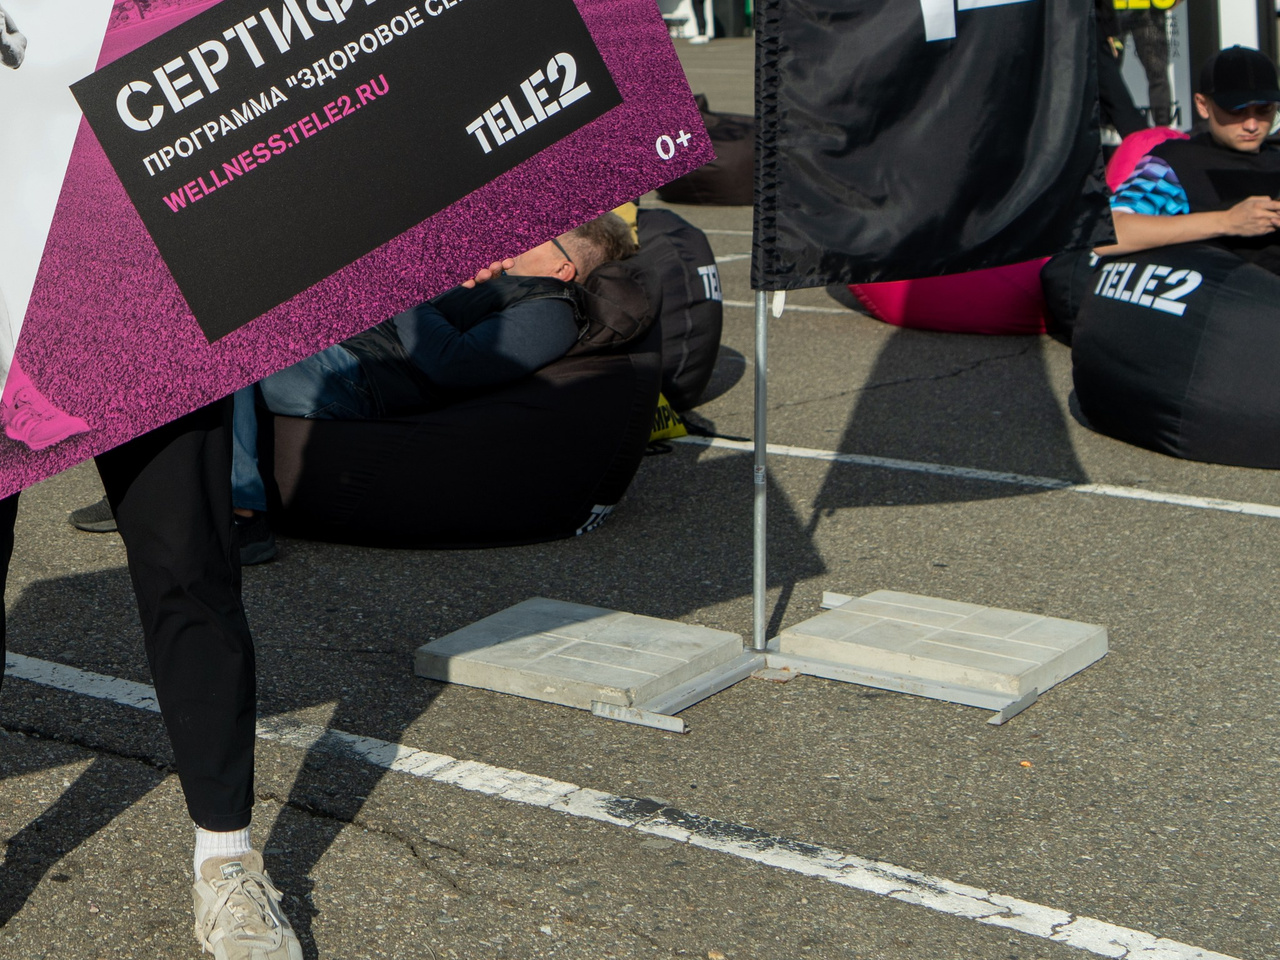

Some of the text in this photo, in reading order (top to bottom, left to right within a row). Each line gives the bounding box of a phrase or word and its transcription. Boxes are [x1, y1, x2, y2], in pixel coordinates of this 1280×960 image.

[142, 86, 289, 177] ПРОГРАММА
[285, 6, 425, 91] "ЗДОРОВОЕ
[465, 52, 591, 154] TELE2
[162, 73, 391, 213] WELLNESS.TELE2.RU
[655, 130, 691, 160] 0+
[697, 264, 722, 302] TE
[1094, 262, 1202, 316] TELE2
